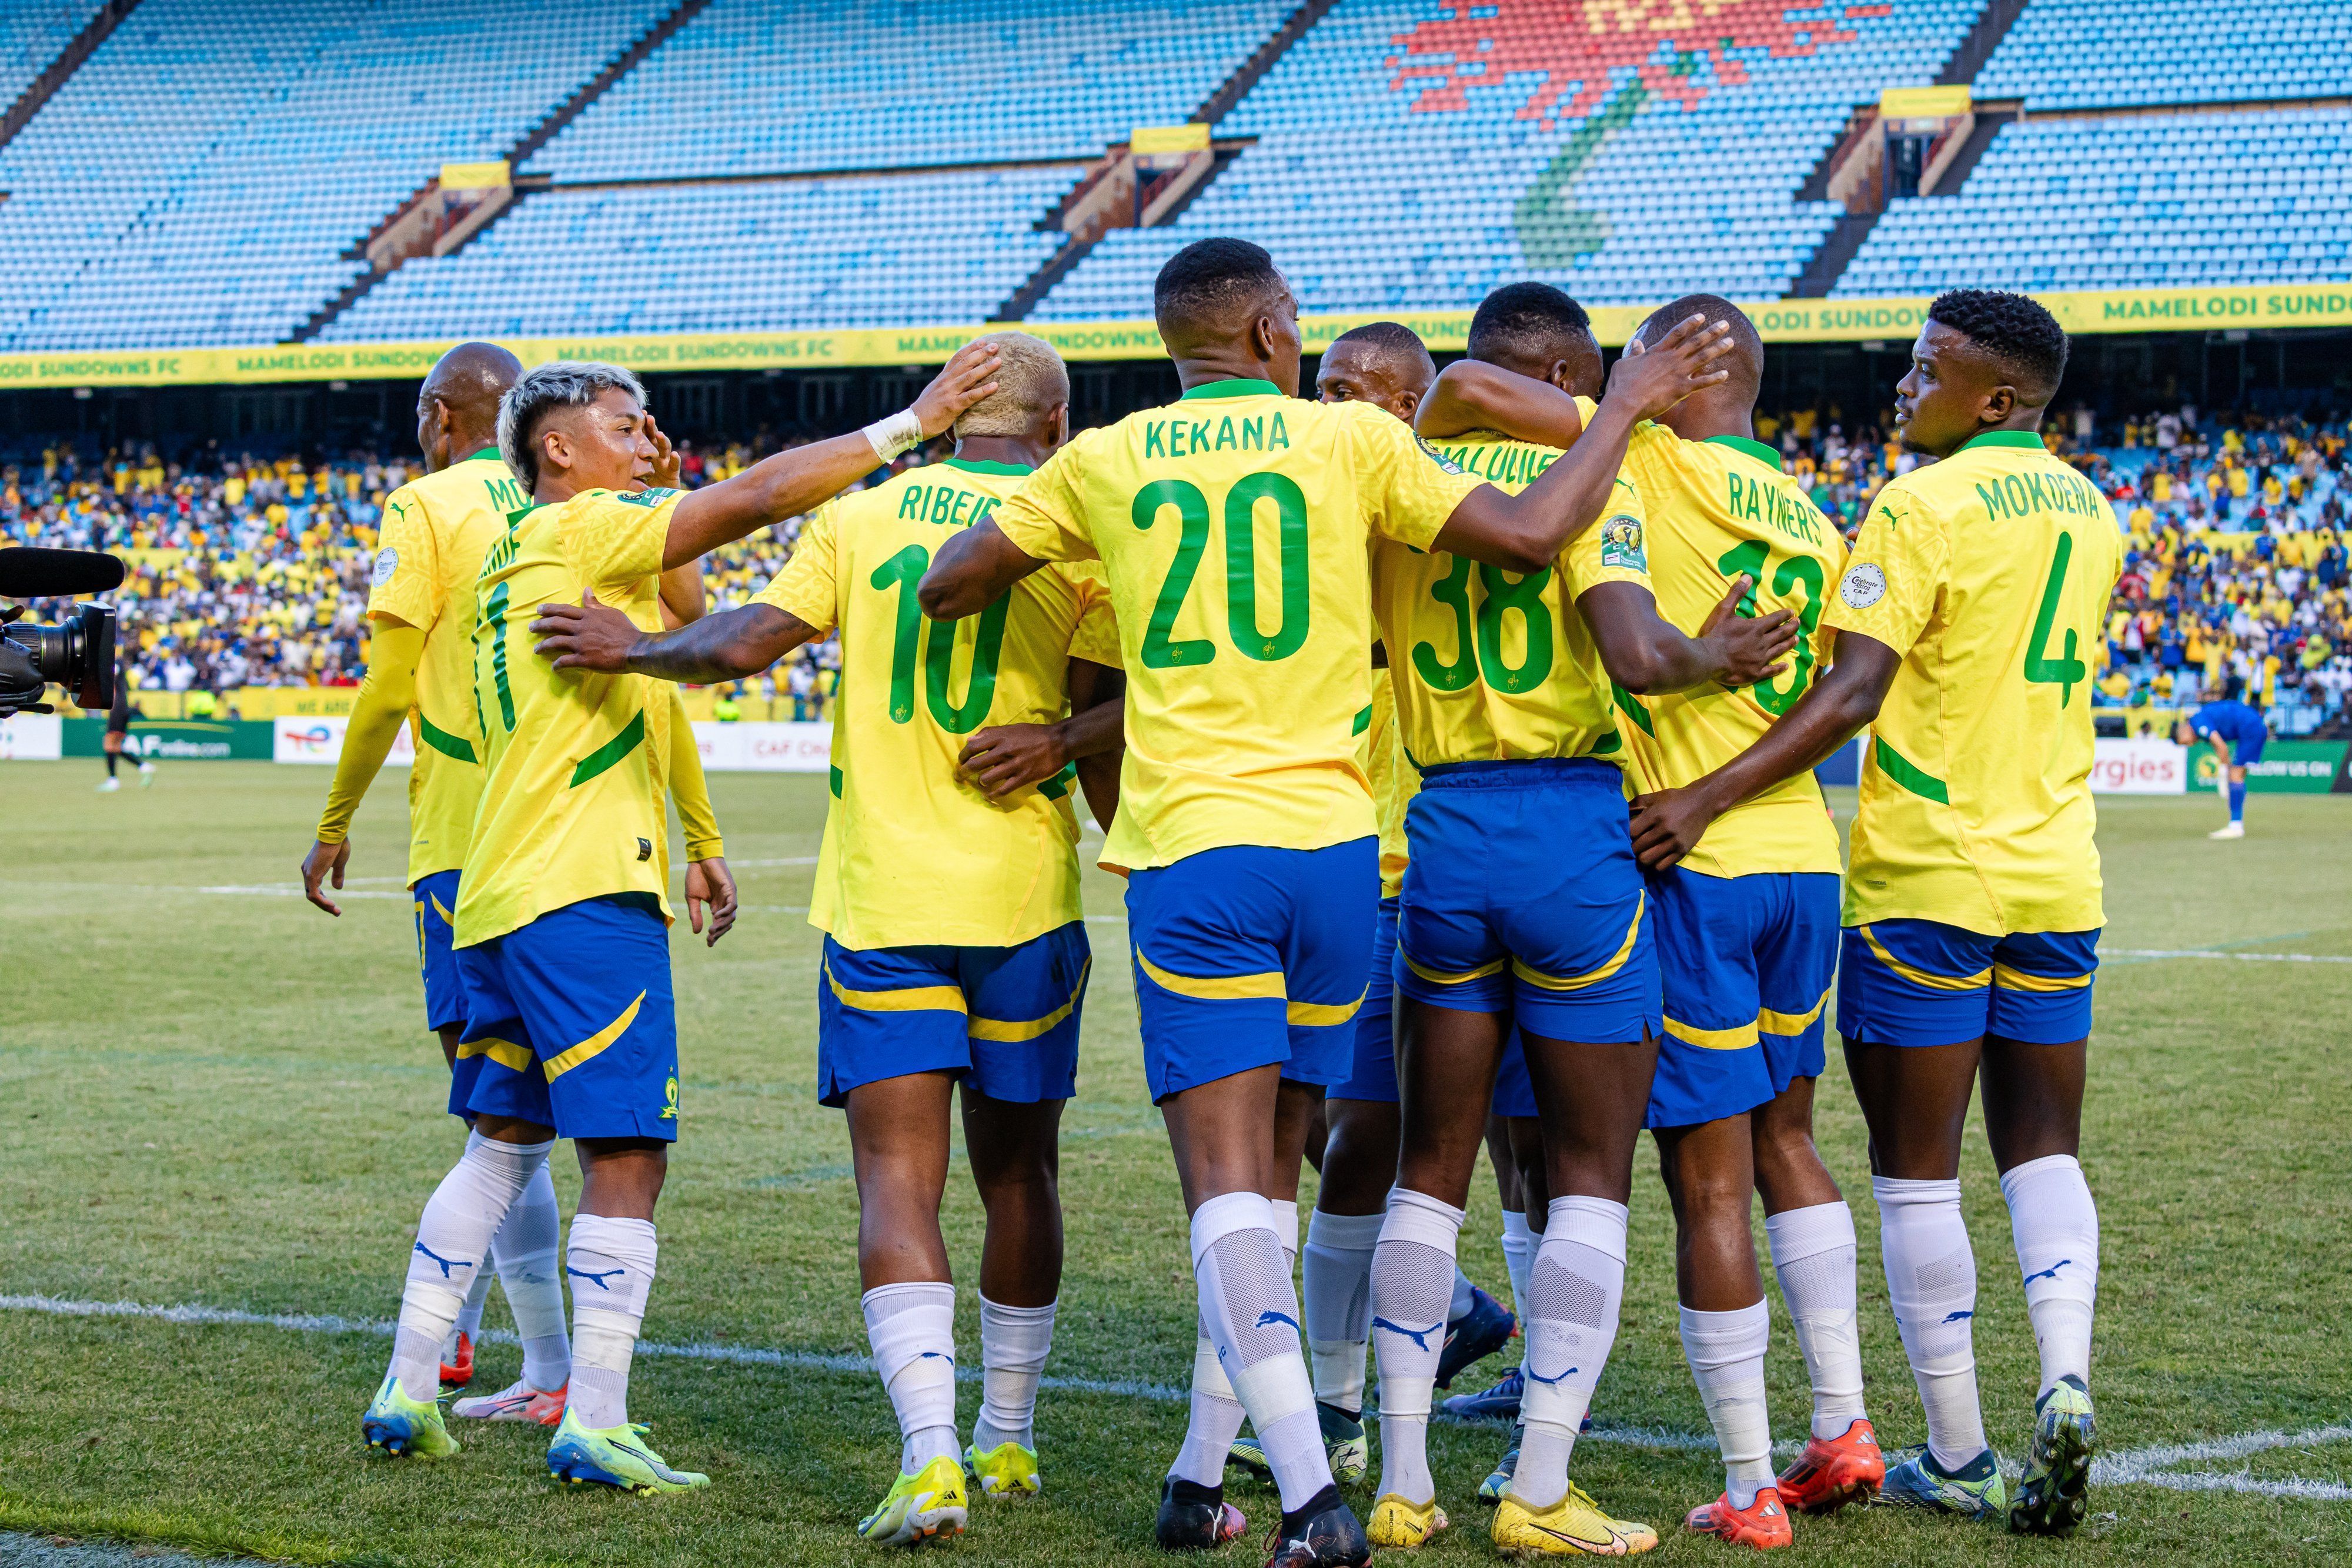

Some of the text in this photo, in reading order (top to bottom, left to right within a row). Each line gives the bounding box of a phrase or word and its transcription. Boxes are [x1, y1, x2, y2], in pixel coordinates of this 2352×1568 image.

[2103, 294, 2352, 320] MAMELODI SUND
[39, 357, 151, 377] SUNDOWNS
[157, 357, 179, 375] FC
[236, 352, 346, 371] MAMELODI
[557, 338, 833, 362] MAMELODI SUNDOWNS FC
[1145, 412, 1289, 459] KEKANA
[1728, 472, 1822, 548] RAYNERS
[1975, 472, 2100, 522] MOKOENA
[1131, 472, 1309, 669] 20
[1852, 576, 1878, 588] Celebrate
[1853, 581, 1871, 591] Africa
[870, 544, 1012, 734] 10
[1406, 543, 1553, 694] 38
[2024, 531, 2086, 710] 4
